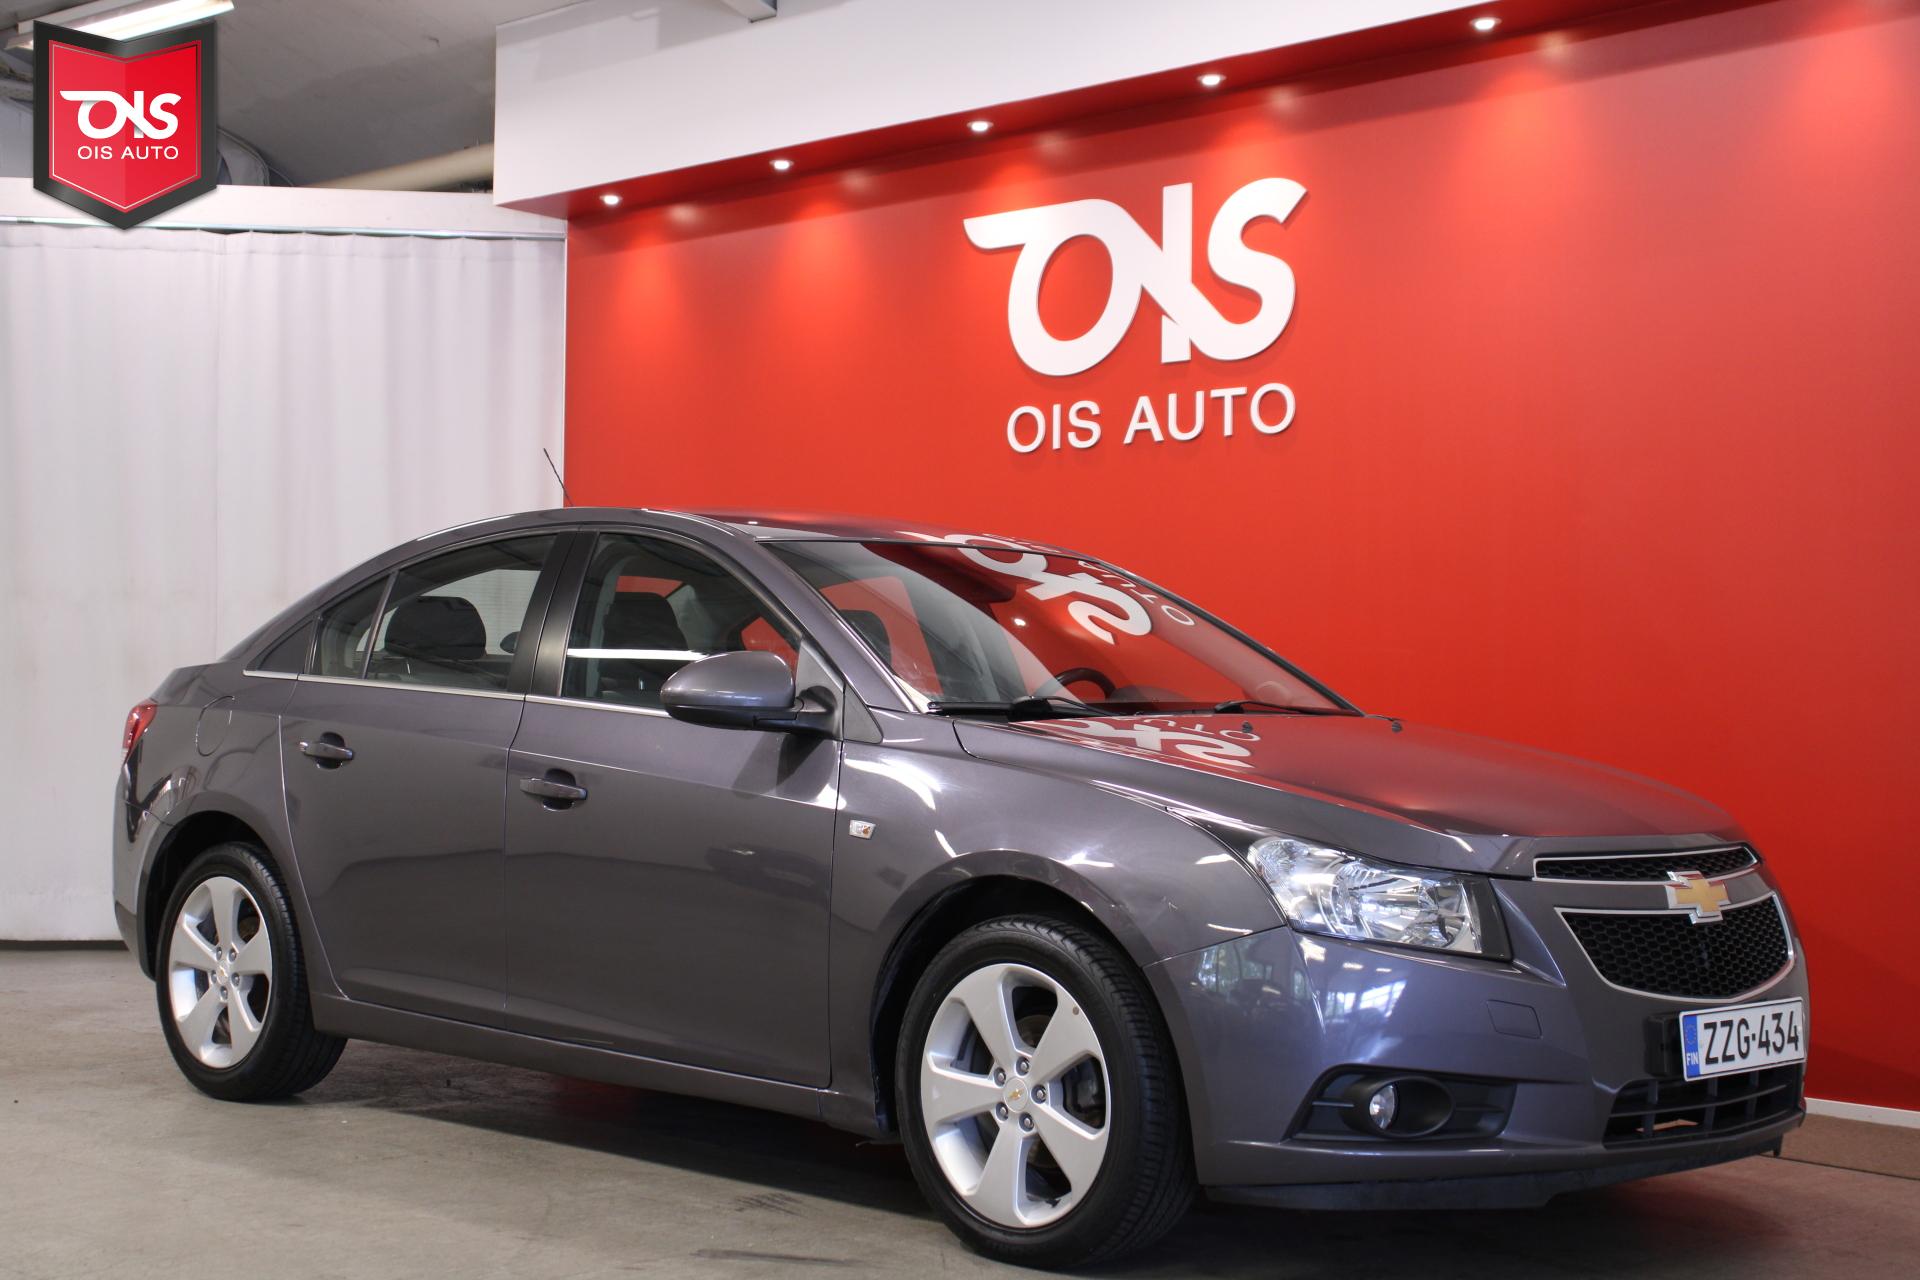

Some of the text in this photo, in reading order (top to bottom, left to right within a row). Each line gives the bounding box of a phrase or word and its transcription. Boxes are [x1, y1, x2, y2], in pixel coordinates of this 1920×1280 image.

[1006, 382, 1296, 453] OIS AUTO
[1686, 1052, 1699, 1066] FIN
